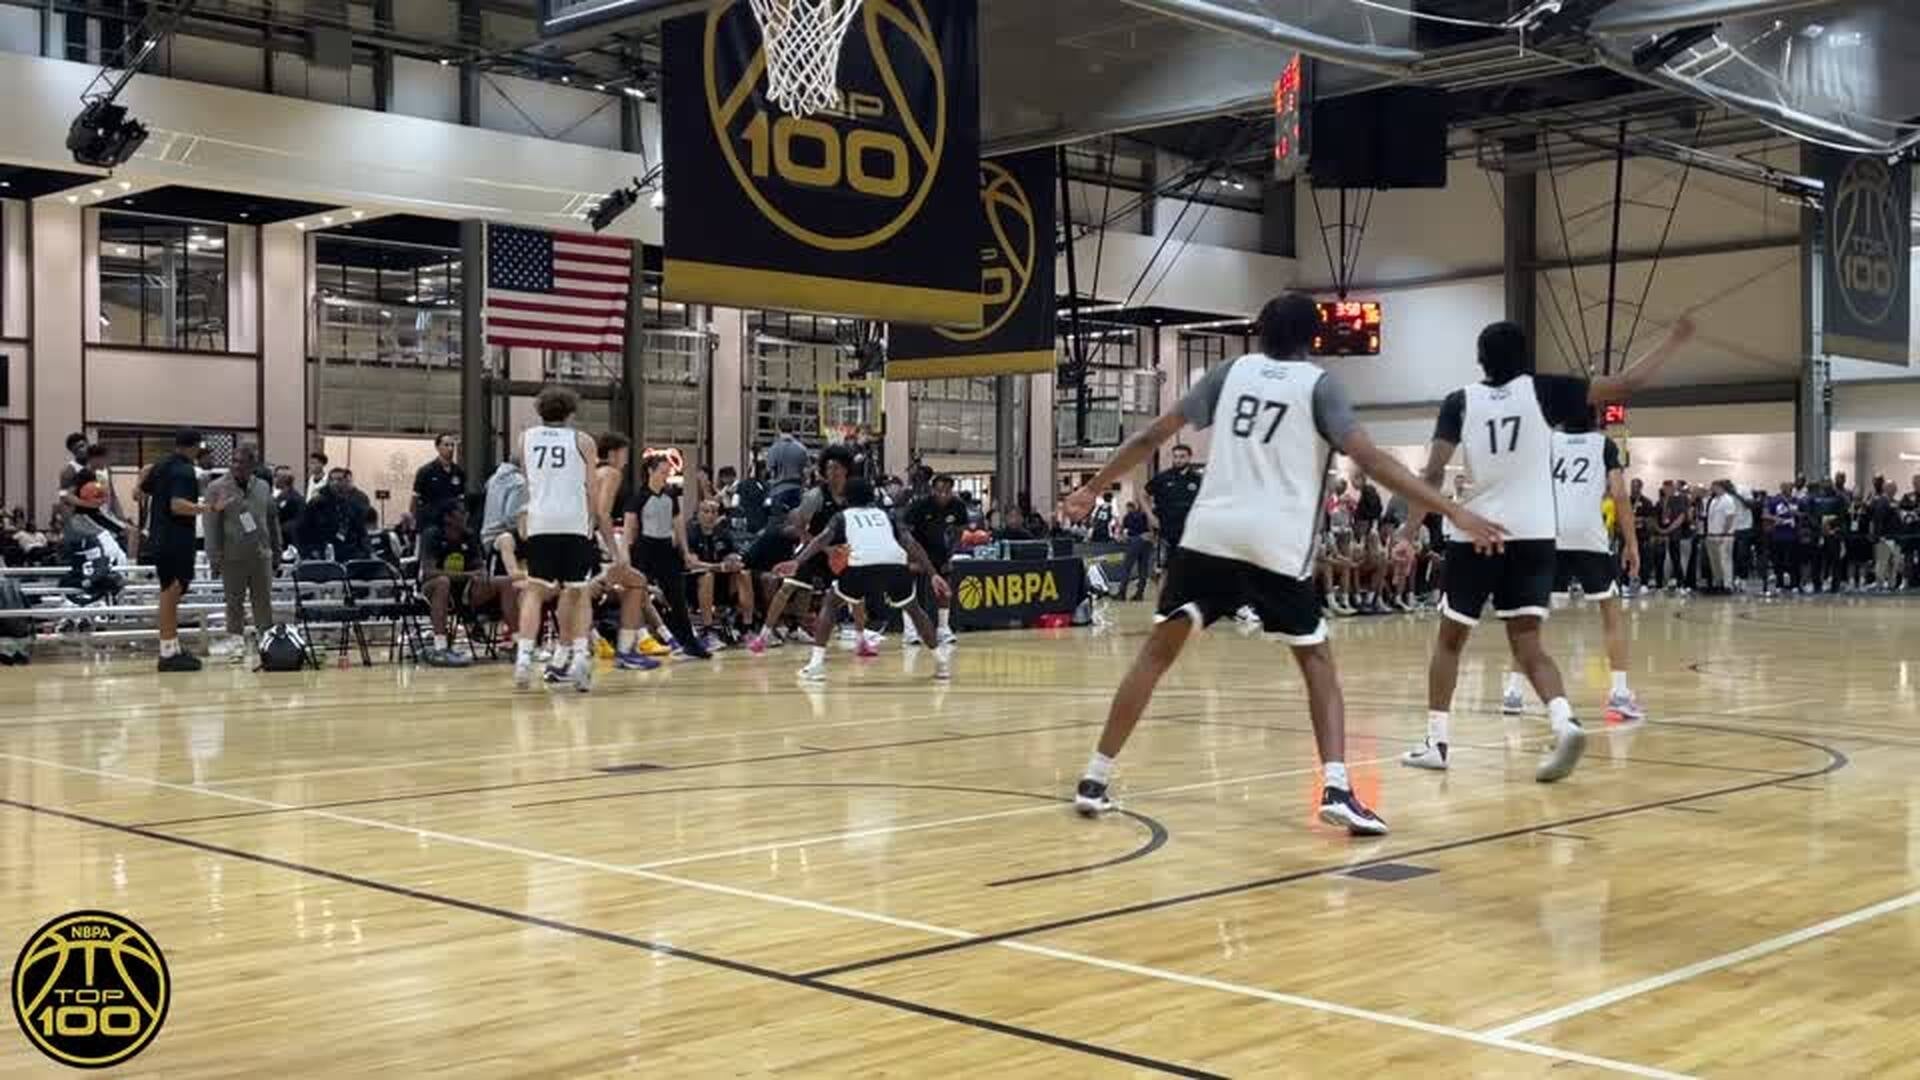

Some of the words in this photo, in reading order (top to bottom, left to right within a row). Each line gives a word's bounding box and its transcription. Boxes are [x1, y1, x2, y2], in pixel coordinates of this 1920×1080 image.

[741, 110, 910, 198] 100
[1845, 255, 1891, 297] 100
[1232, 394, 1289, 444] 87
[1605, 405, 1625, 422] 24
[1485, 415, 1521, 454] 17
[533, 445, 566, 469] 79
[1553, 457, 1591, 484] 42
[852, 512, 887, 529] 115
[983, 571, 1060, 607] NBPA
